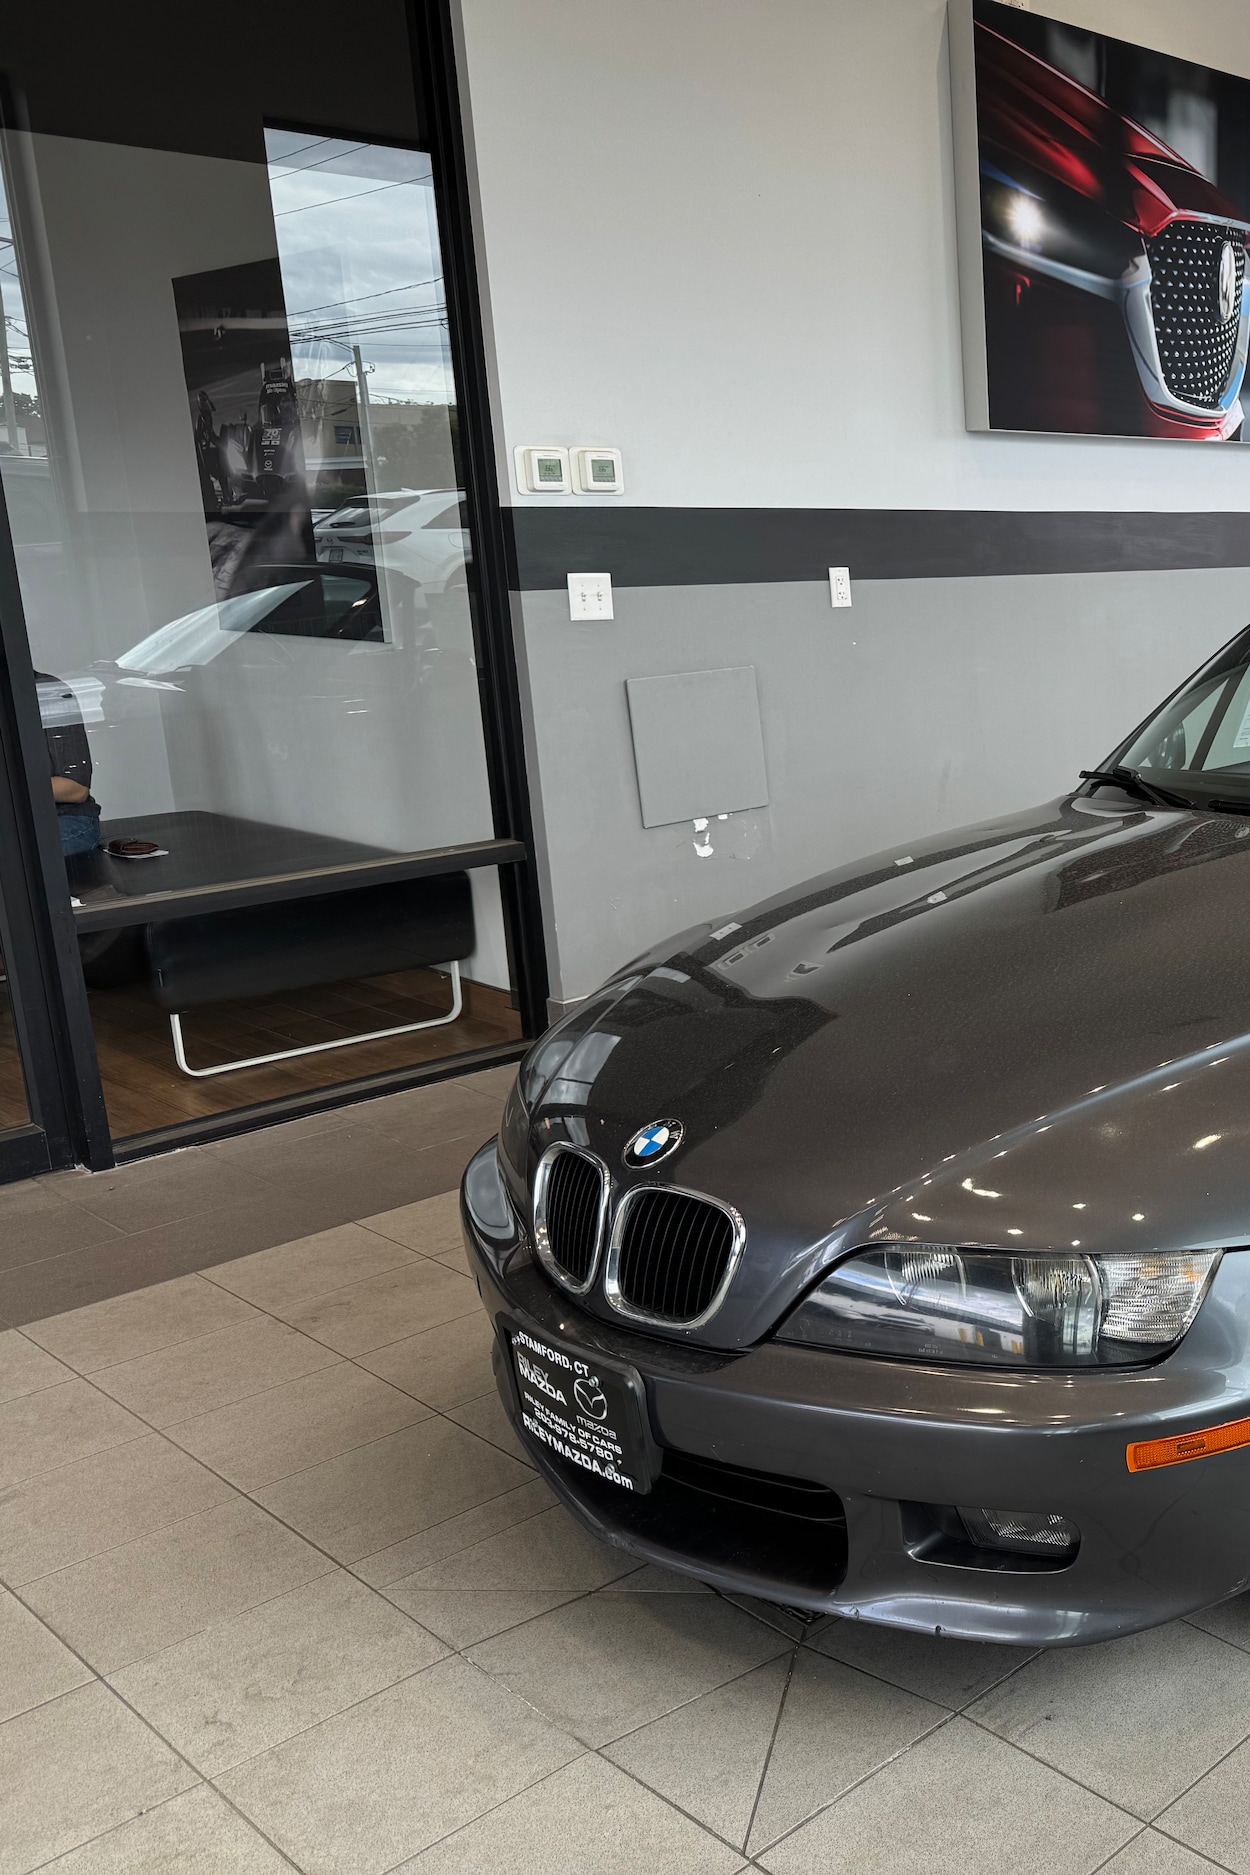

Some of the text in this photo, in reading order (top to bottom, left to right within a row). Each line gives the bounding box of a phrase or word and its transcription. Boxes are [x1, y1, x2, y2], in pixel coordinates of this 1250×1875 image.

[516, 1350, 549, 1382] RILEY
[518, 1330, 589, 1377] STAMFORD, CT
[519, 1361, 568, 1406] MAZDA
[523, 1391, 623, 1455] RILEY FAMILY OF CARS
[576, 1414, 617, 1440] mazda
